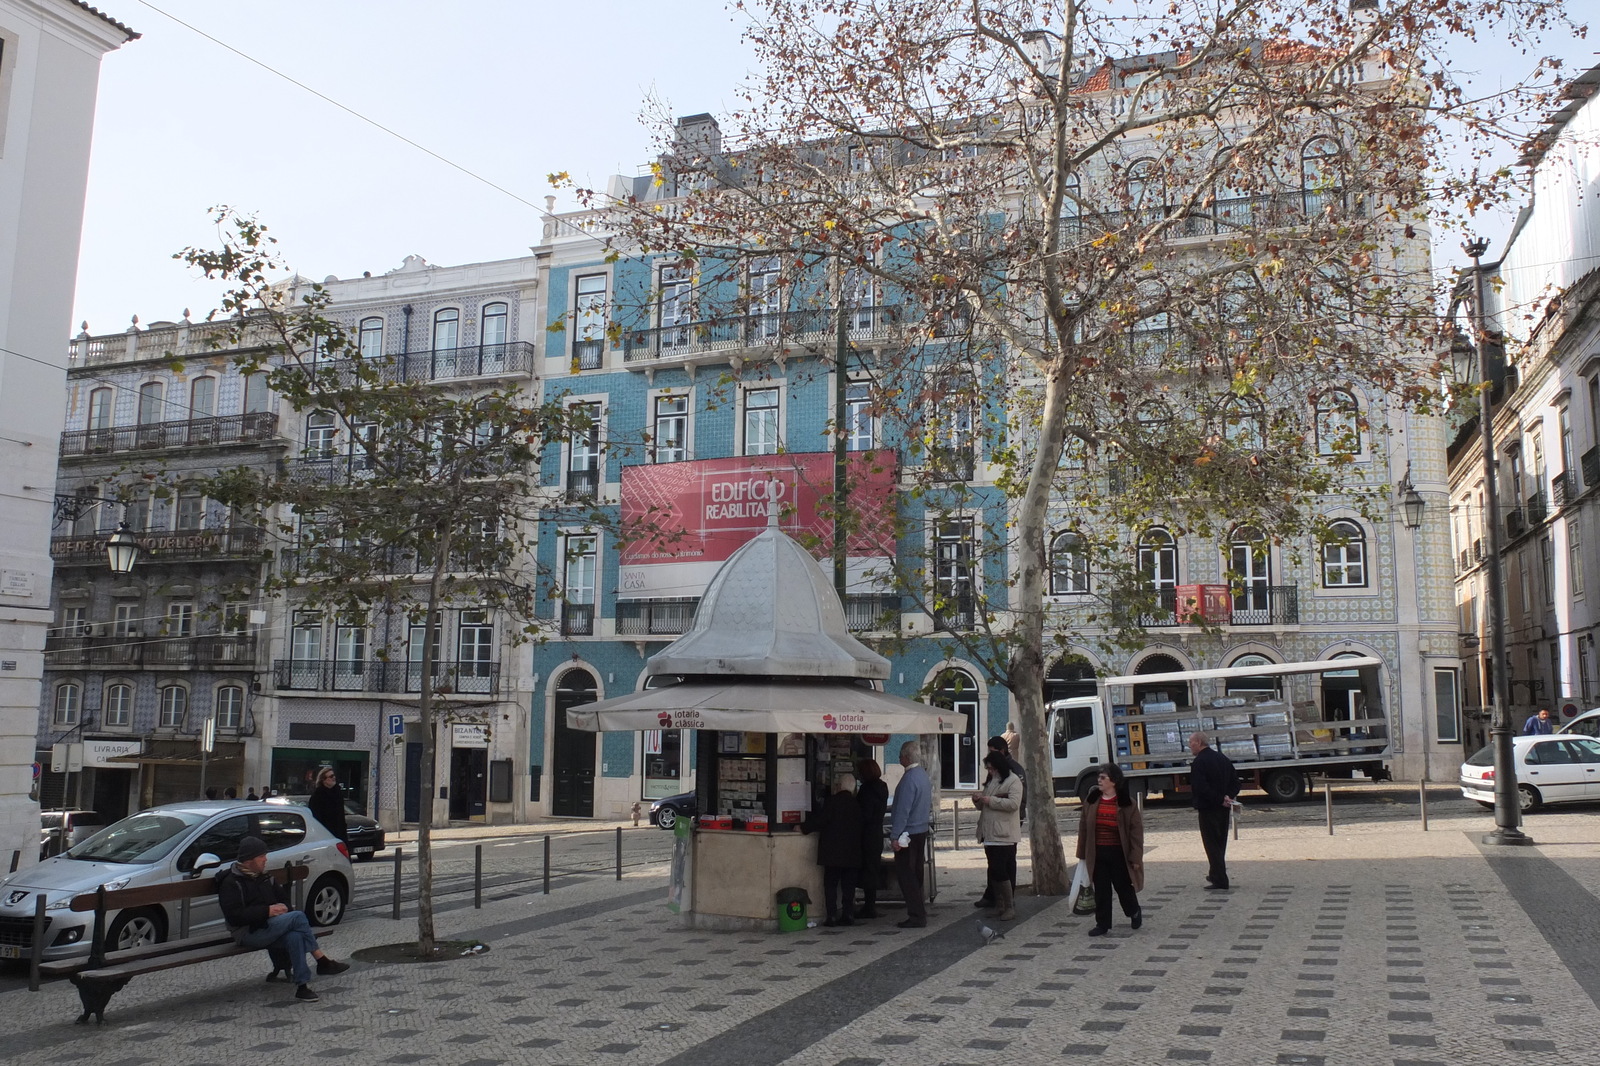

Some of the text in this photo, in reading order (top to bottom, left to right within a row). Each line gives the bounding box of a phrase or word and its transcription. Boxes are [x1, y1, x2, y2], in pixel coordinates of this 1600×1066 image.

[711, 477, 785, 502] EDIFÍCIO
[176, 535, 221, 548] LISBOA
[624, 571, 646, 580] SANTA
[624, 580, 646, 589] CASA
[1204, 594, 1214, 607] T1
[674, 710, 700, 718] lotaria
[392, 716, 400, 733] P
[674, 720, 704, 728] clássica
[839, 724, 870, 732] popular
